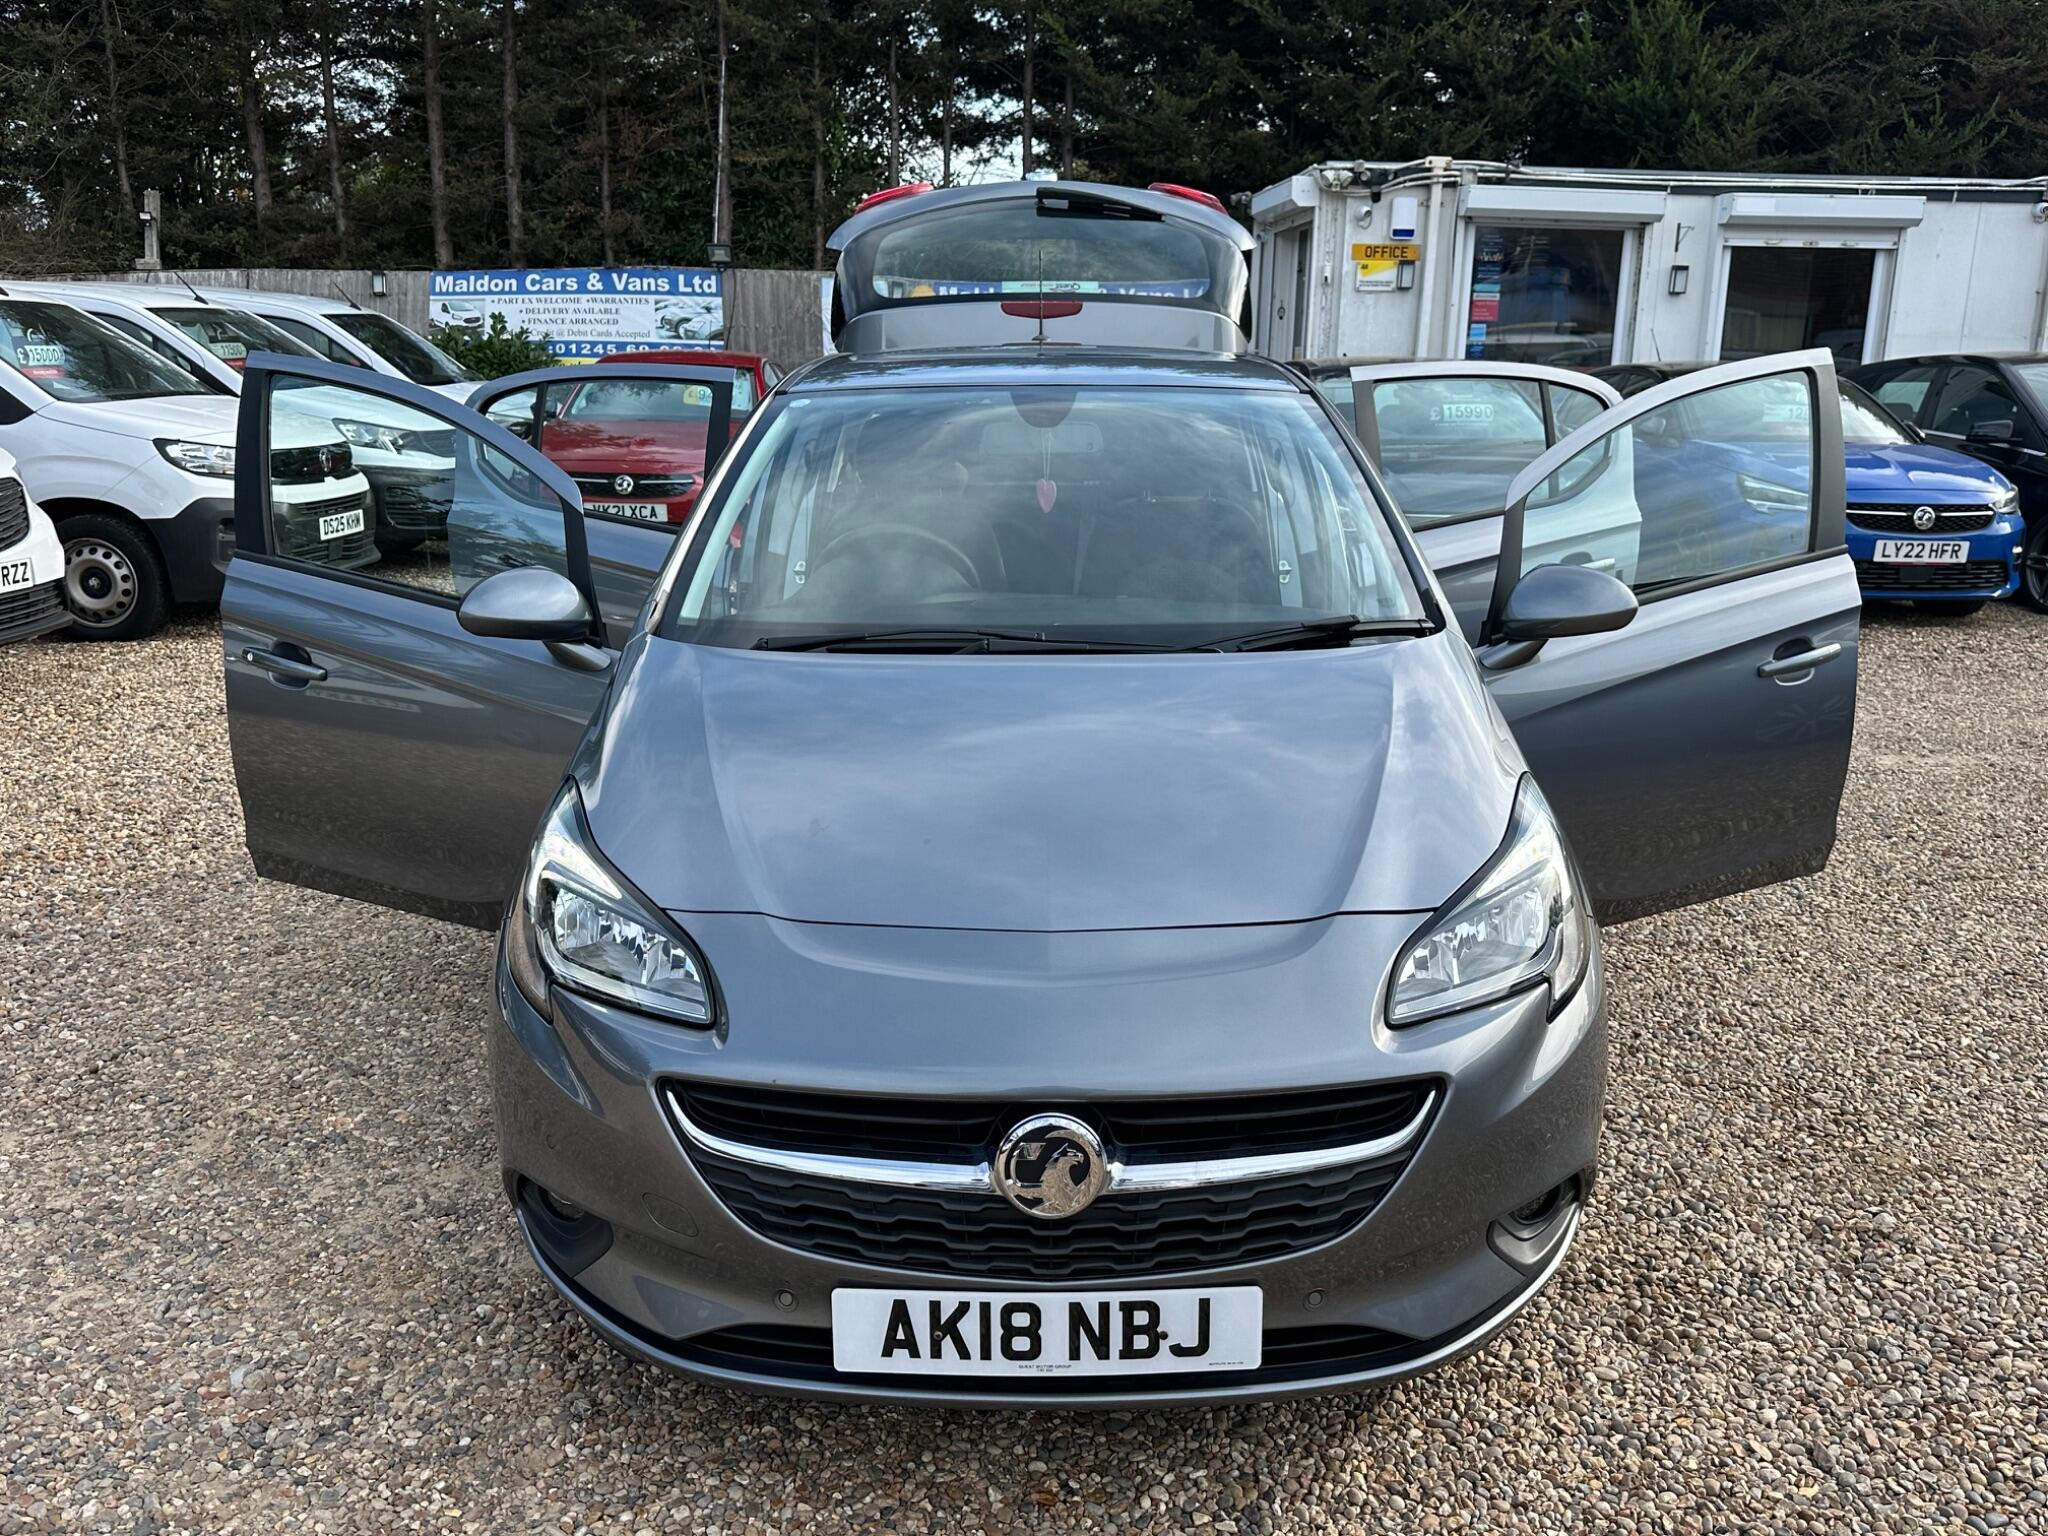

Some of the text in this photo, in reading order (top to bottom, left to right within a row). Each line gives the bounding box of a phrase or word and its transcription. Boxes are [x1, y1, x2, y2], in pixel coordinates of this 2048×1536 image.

[1365, 246, 1409, 258] OFFICE
[435, 272, 717, 293] Maldon Cars & Vans Ltd
[497, 297, 519, 305] PART
[521, 297, 534, 305] EX
[535, 297, 581, 305] WELCOME
[525, 307, 621, 315] DELIVERY AVAILABLE
[527, 317, 619, 326] FINANCE ARRANGED
[567, 328, 588, 337] Debit
[589, 328, 614, 338] Cards
[614, 329, 651, 340] Accepted
[1430, 406, 1493, 420] £ 15990
[629, 505, 658, 519] XCA
[323, 516, 345, 535] DS25
[1881, 542, 1962, 559] LY22 HFR
[1, 561, 30, 587] RZZ
[881, 1297, 1211, 1361] AK18 NBJ
